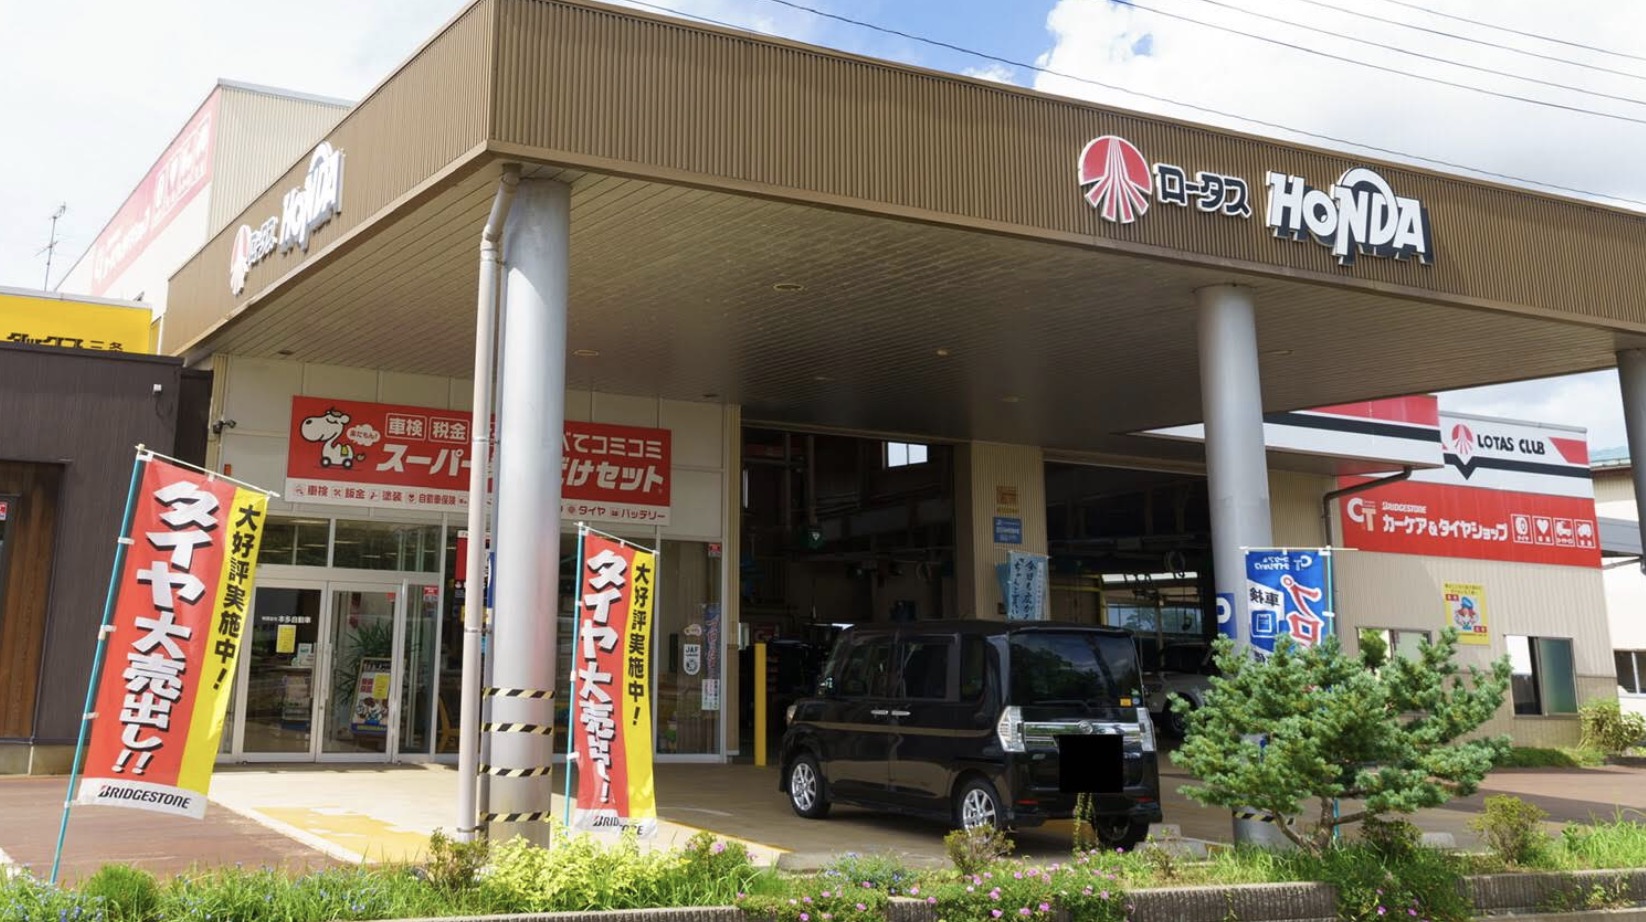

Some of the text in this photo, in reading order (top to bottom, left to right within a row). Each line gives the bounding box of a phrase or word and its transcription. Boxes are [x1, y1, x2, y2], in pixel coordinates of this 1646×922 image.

[280, 141, 342, 250] HONDA
[1154, 164, 1428, 262] ロータス HONDA
[388, 418, 423, 437] 車検
[432, 421, 466, 440] 税金
[1477, 434, 1546, 455] LOTAS CLUB
[579, 505, 606, 516] タイヤ
[627, 562, 651, 726] 大好評実施中!
[98, 785, 192, 810] BRIDGESTONE
